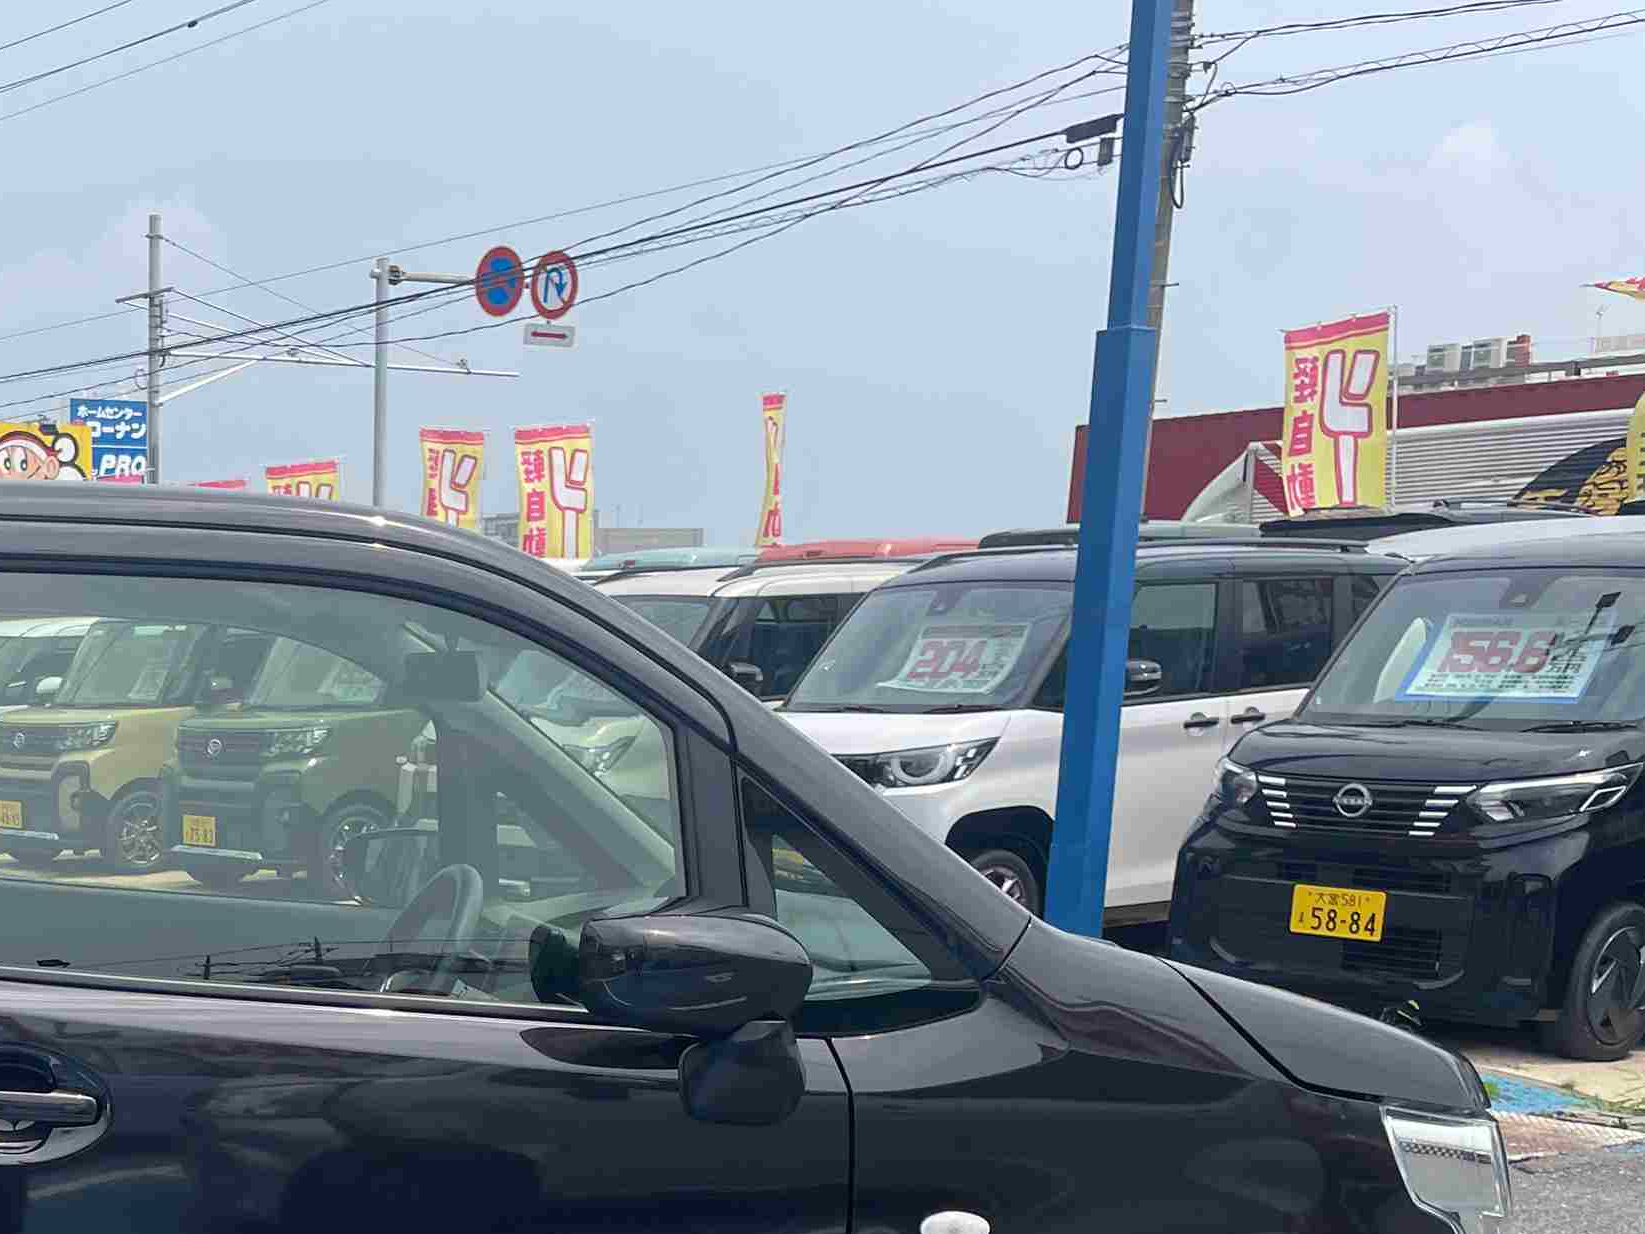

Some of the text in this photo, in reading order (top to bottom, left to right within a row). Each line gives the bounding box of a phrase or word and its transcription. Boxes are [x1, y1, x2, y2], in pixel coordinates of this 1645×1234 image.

[77, 404, 143, 420] ホームセンター
[86, 421, 147, 439] コーナン
[99, 453, 147, 478] PRO
[1310, 906, 1376, 937] 58-84
